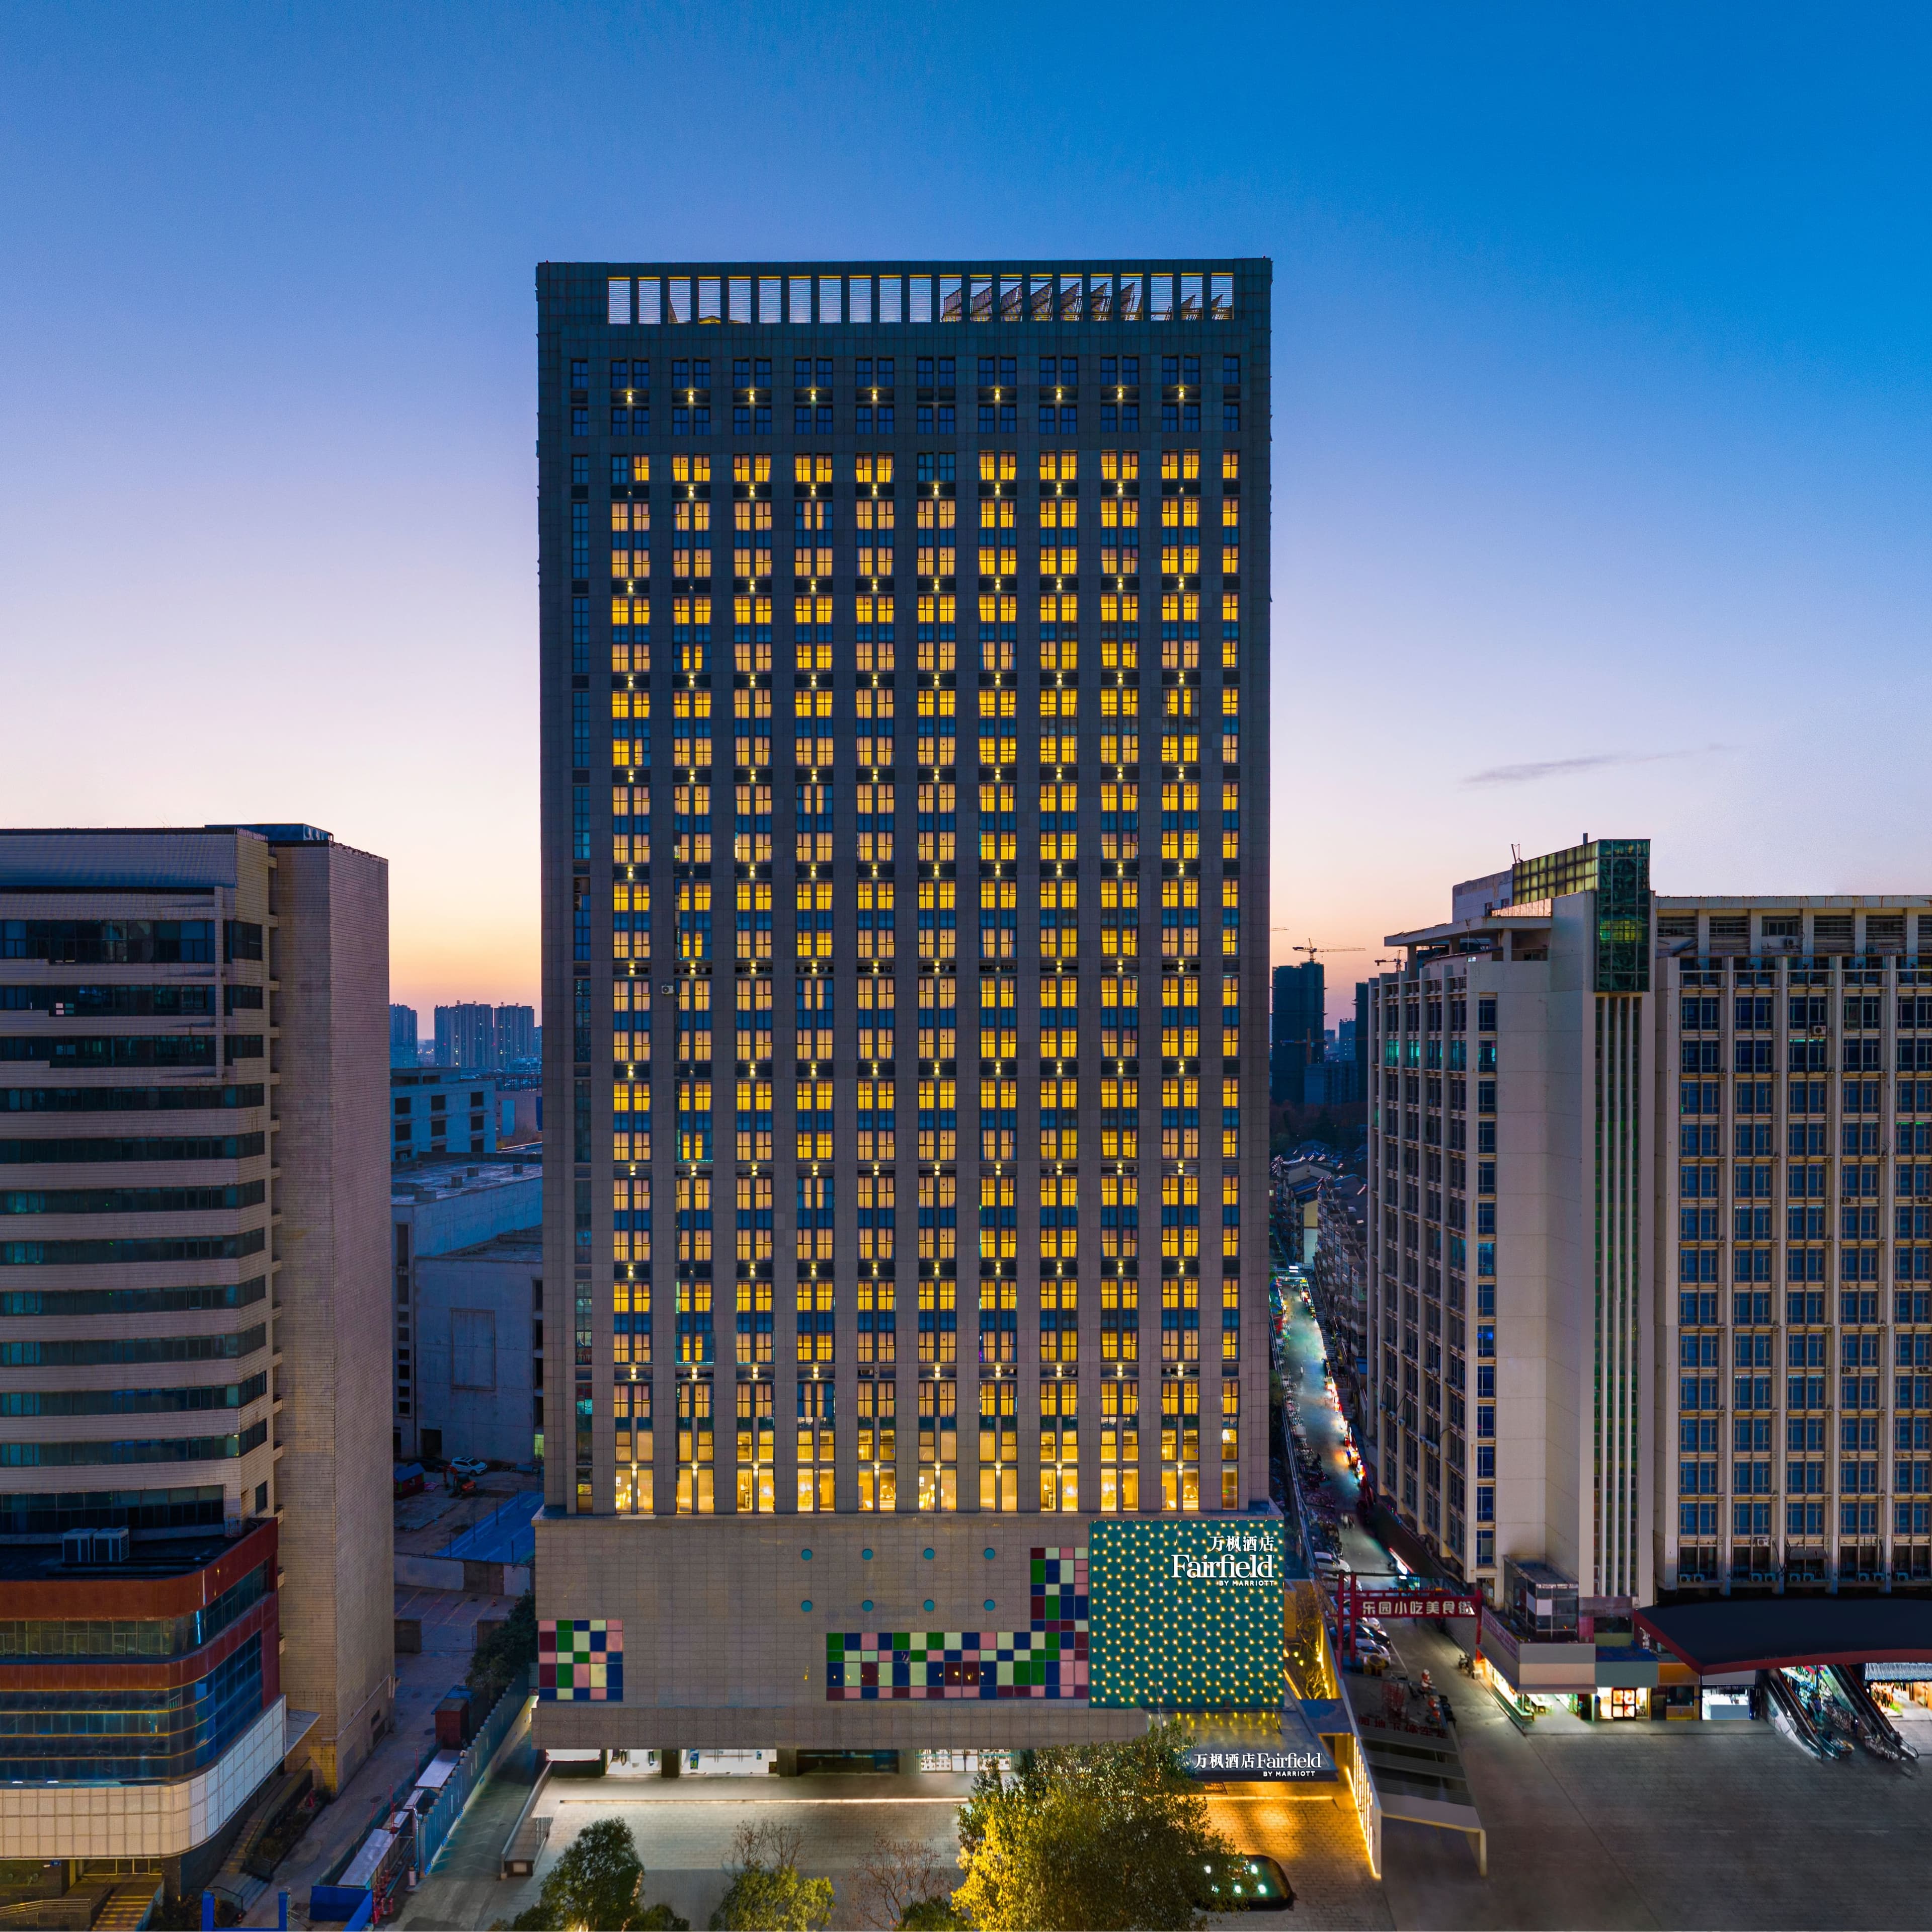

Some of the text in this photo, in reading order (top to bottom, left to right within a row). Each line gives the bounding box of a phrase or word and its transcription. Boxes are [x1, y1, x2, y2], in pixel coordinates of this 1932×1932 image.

[1210, 1535, 1274, 1552] 万枫酒店
[1171, 1554, 1274, 1578] Fairfield
[1362, 1600, 1474, 1615] 乐园小吃美食街
[1193, 1752, 1322, 1769] 万枫酒店 Fairfield
